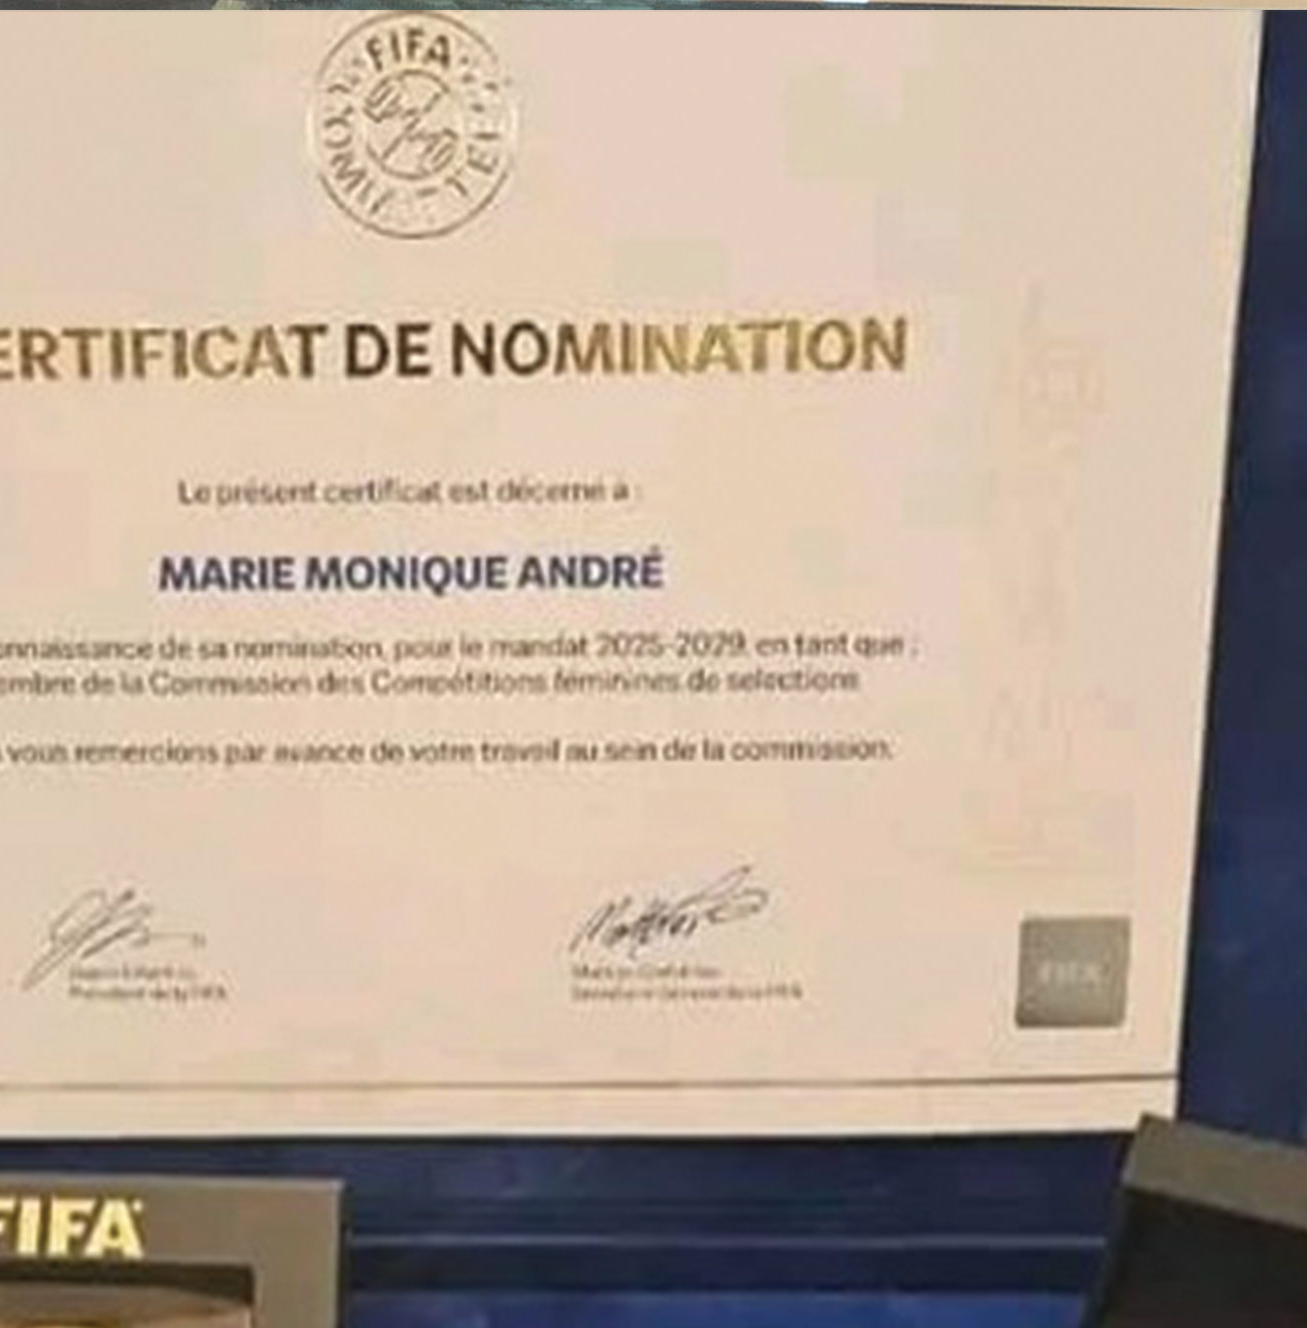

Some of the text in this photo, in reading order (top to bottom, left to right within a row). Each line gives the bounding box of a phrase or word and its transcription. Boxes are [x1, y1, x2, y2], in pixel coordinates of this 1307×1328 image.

[365, 27, 451, 71] FIFA
[345, 323, 432, 378] DE
[452, 317, 906, 376] NOMINATION
[177, 480, 212, 505] Le
[322, 477, 442, 503] certificat
[447, 479, 488, 503] est
[158, 544, 664, 596] MARIE MONIQUE ANDRÉ
[159, 635, 192, 661] de
[198, 641, 228, 660] sa
[393, 640, 452, 663] pour
[459, 634, 484, 658] le
[488, 632, 587, 658] mandat
[754, 637, 788, 657] en
[793, 633, 849, 658] tant
[853, 635, 905, 661] que
[82, 670, 116, 695] de
[120, 670, 145, 695] la
[148, 670, 312, 696] Commission
[317, 668, 367, 695] des
[686, 667, 721, 693] de
[6, 743, 70, 764] vous
[74, 737, 220, 764] remercions
[225, 743, 266, 767] par
[273, 743, 365, 763] avance
[370, 740, 405, 763] de
[408, 741, 475, 763] votre
[481, 737, 561, 762] travail
[565, 743, 598, 762] au
[603, 738, 657, 762] sein
[662, 737, 697, 762] de
[702, 737, 726, 762] la
